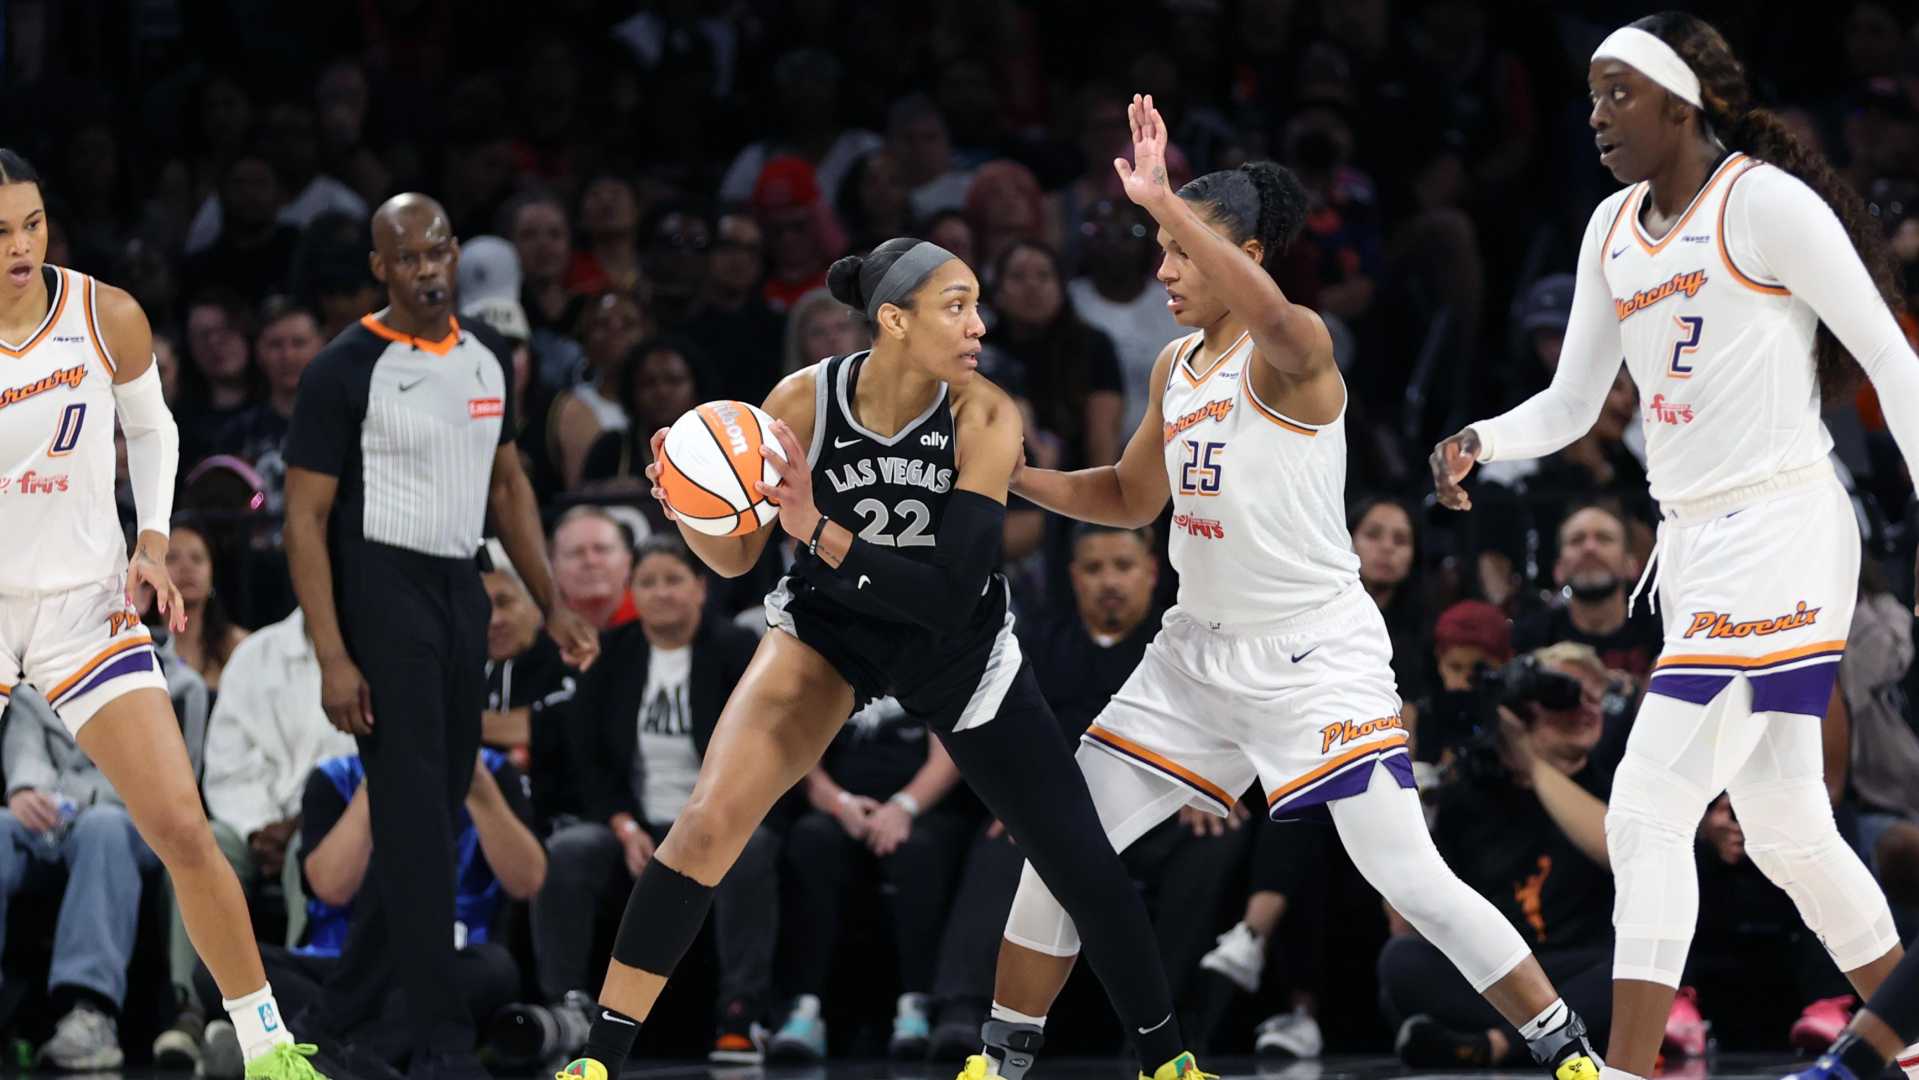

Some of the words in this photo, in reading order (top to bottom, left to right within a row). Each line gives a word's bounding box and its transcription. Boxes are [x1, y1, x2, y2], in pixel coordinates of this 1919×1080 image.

[1668, 316, 1703, 378] 2
[0, 364, 88, 410] rcury
[49, 403, 87, 456] 0
[920, 432, 949, 450] ally
[825, 459, 877, 493] LAS
[877, 457, 953, 494] VEGAS
[1179, 440, 1227, 496] 25
[853, 498, 936, 547] 22
[1683, 600, 1822, 639] Phoenix
